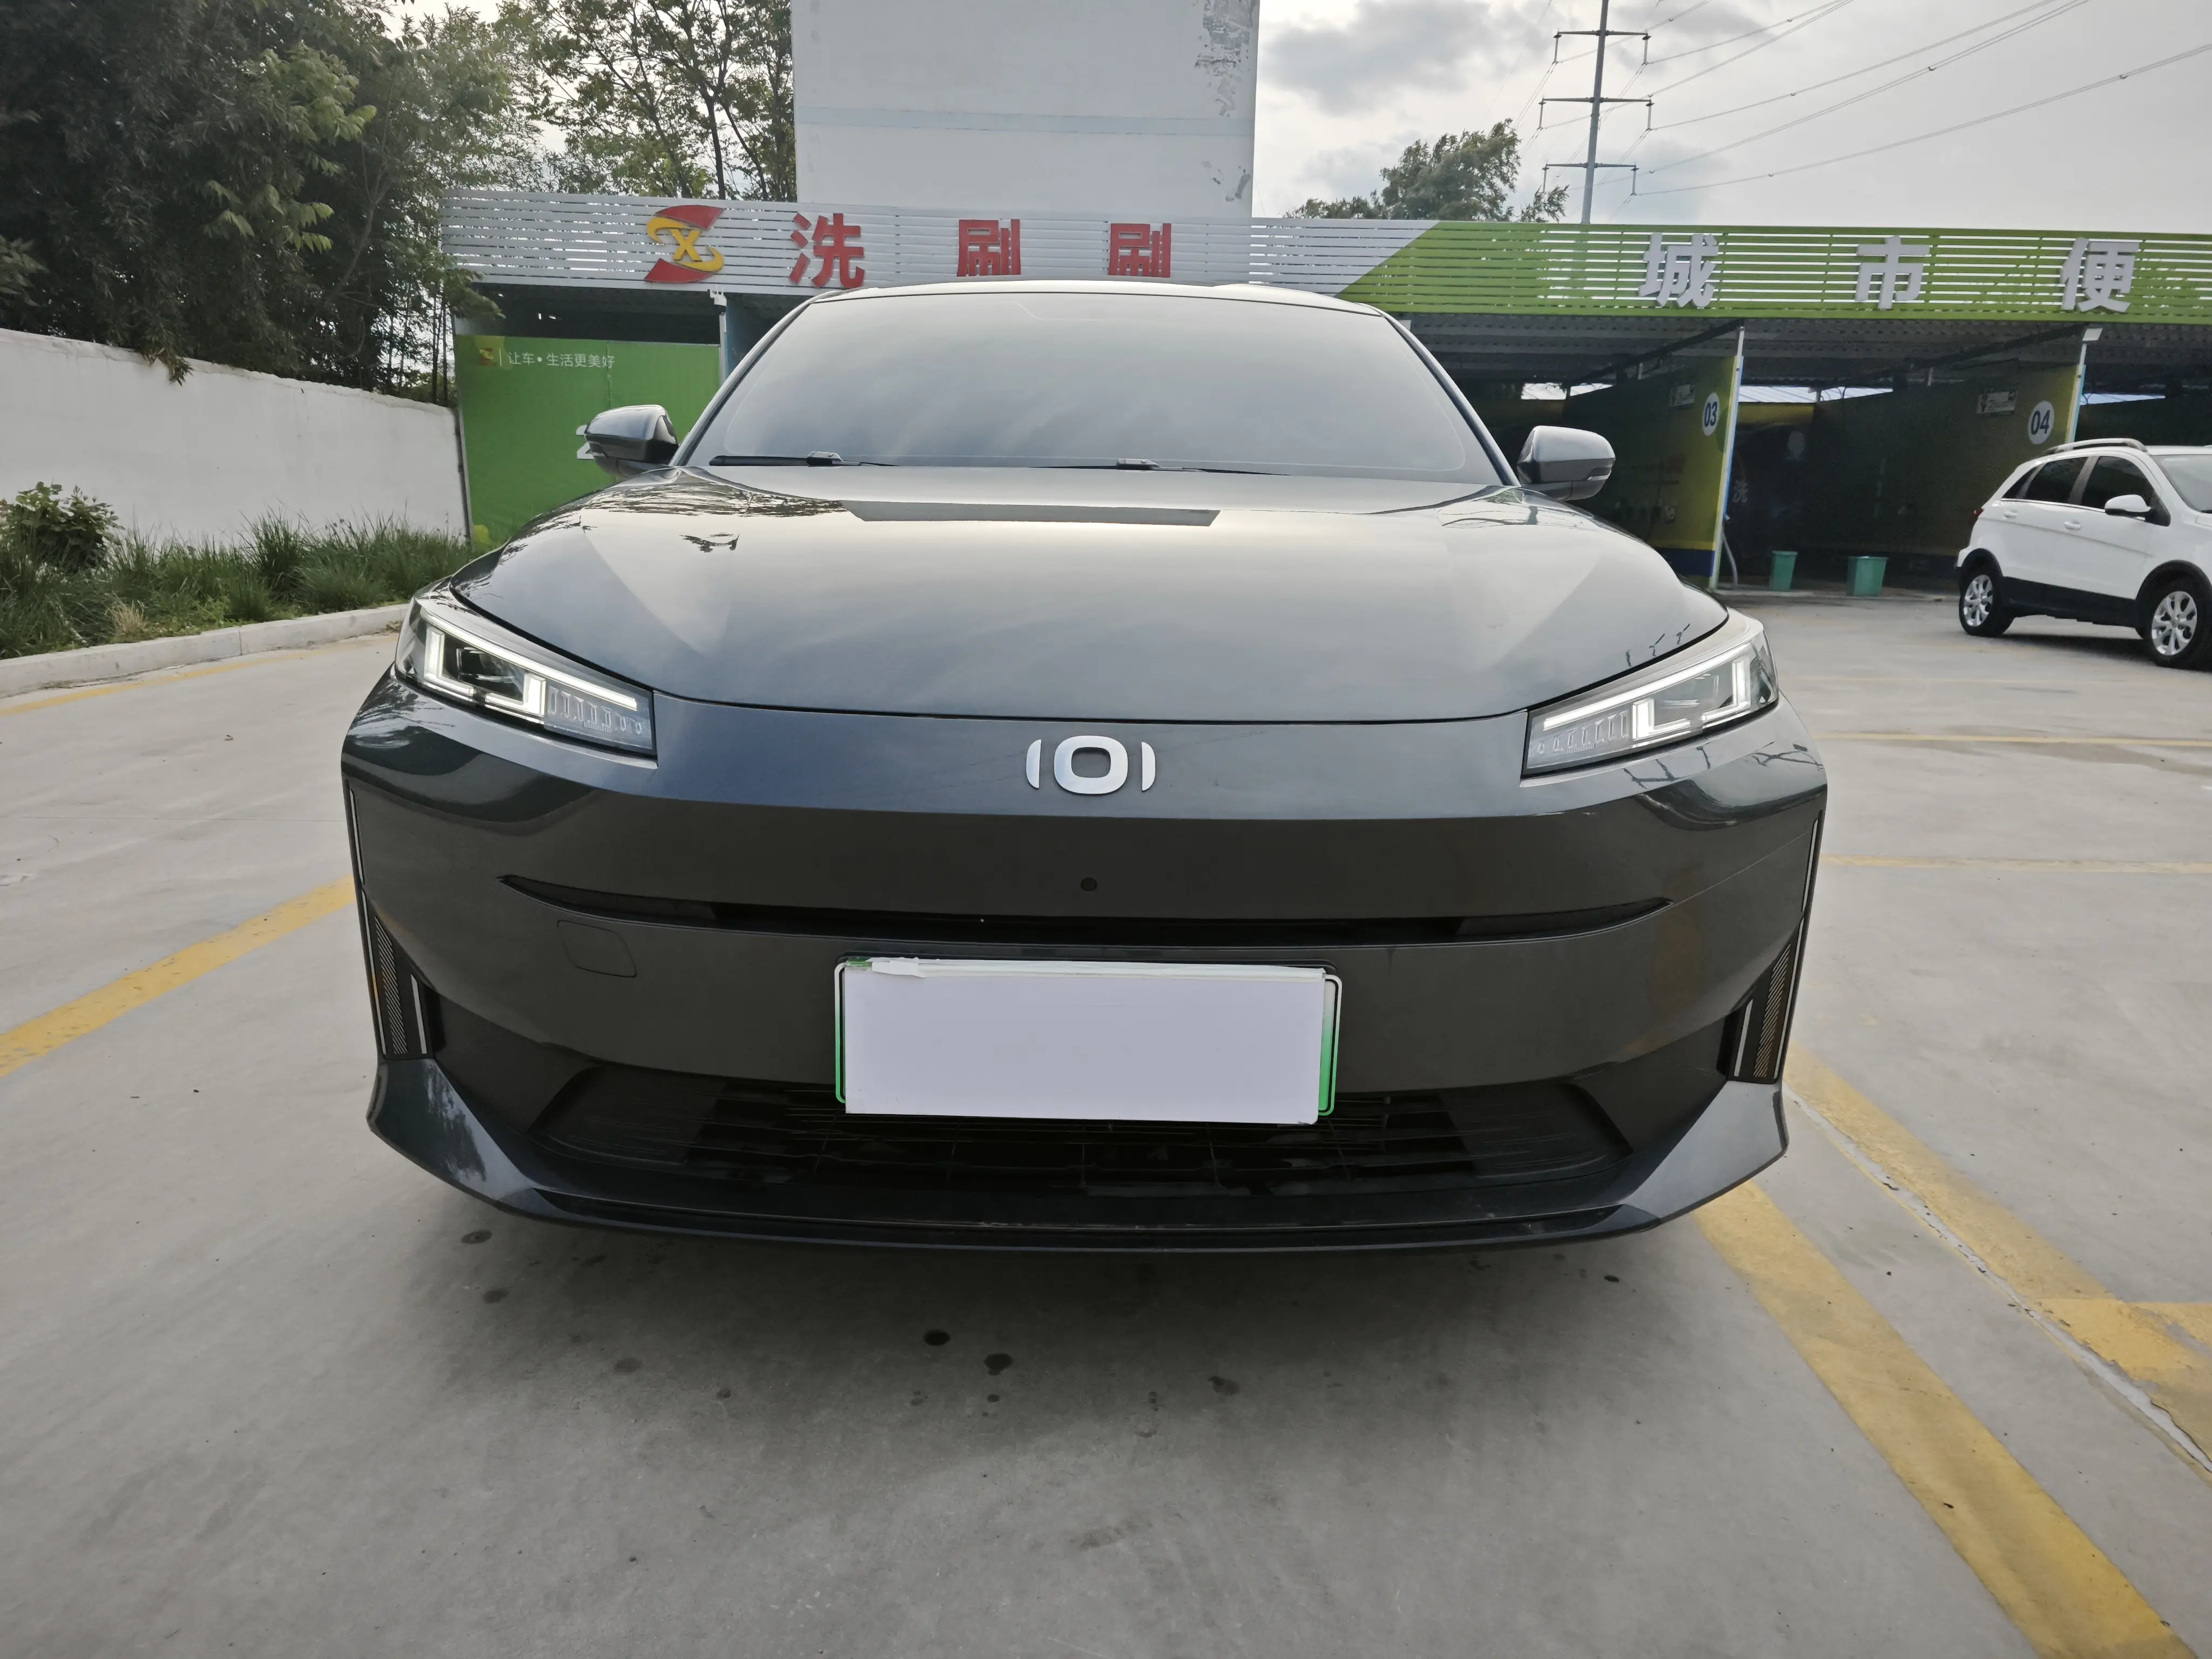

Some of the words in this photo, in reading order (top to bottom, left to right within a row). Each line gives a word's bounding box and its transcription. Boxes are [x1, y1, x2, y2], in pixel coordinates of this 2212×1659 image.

[789, 213, 1172, 288] 洗刷刷
[1638, 233, 2140, 312] 城市便
[1704, 401, 1718, 427] 03
[2031, 410, 2051, 435] 04
